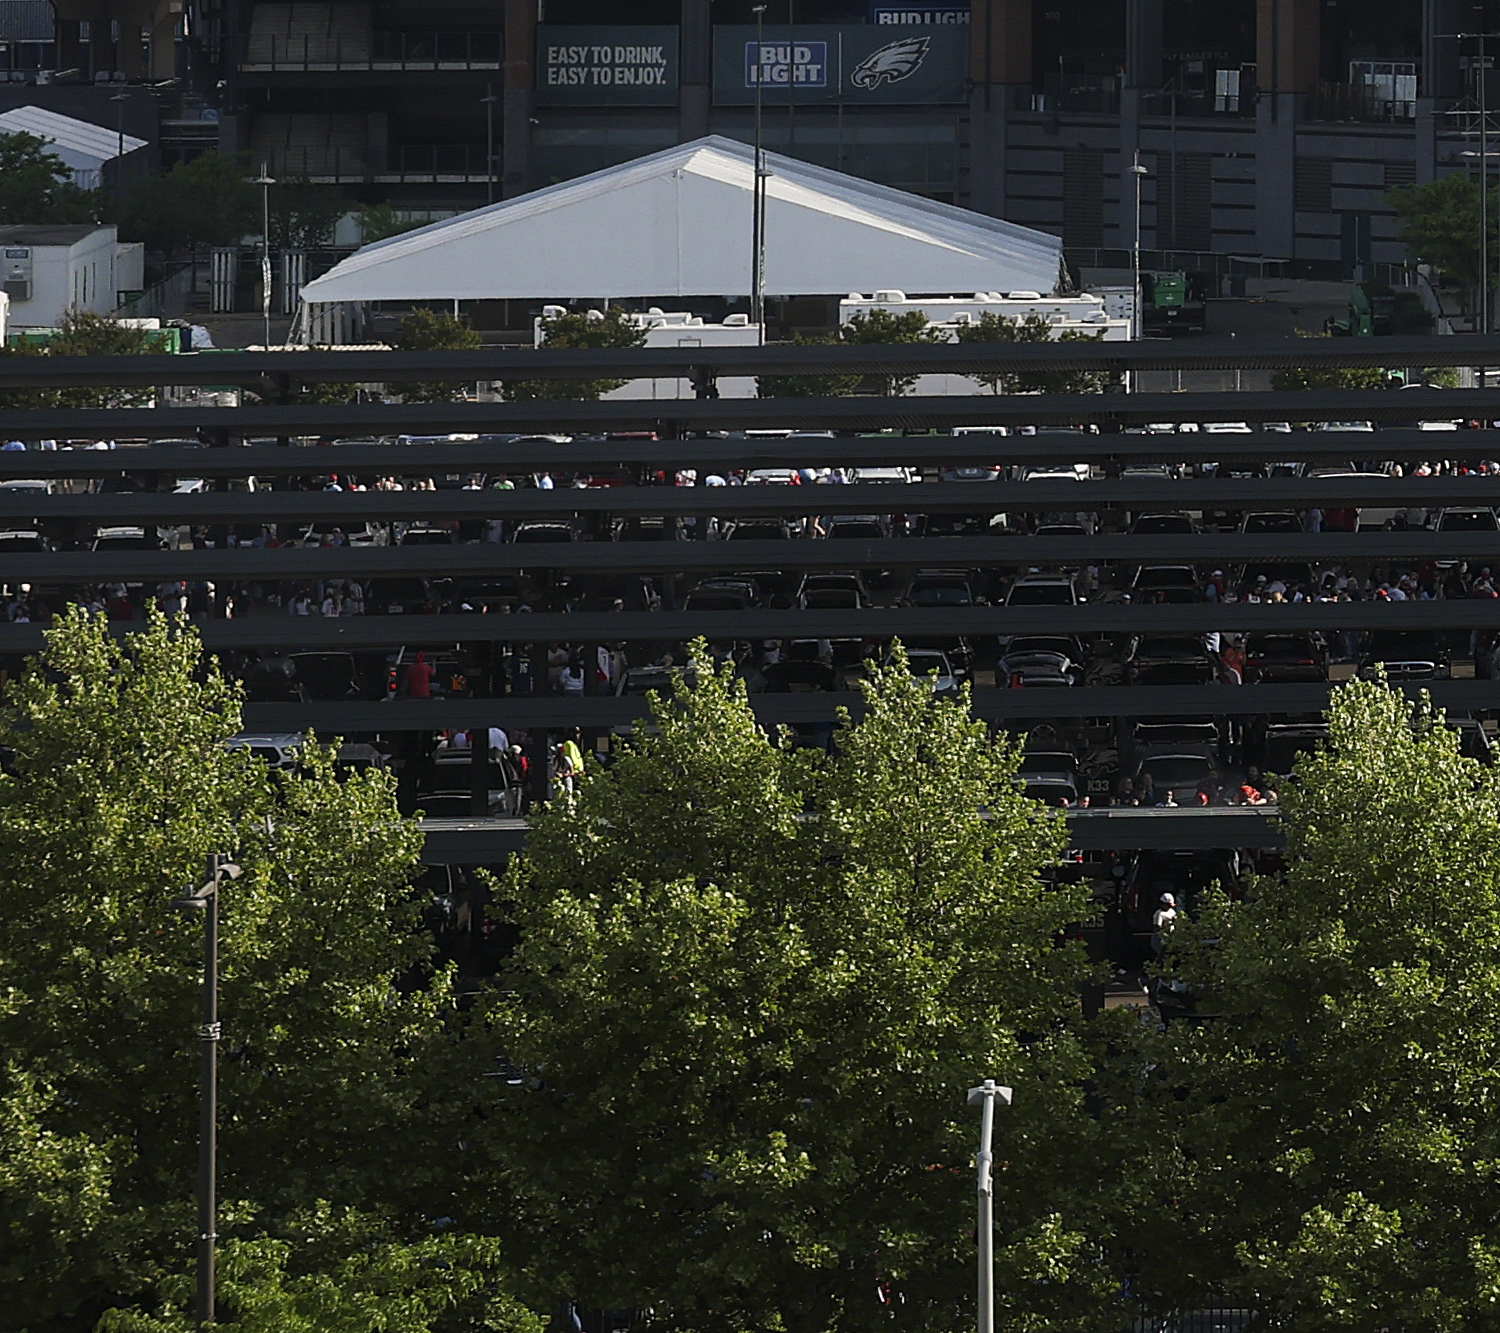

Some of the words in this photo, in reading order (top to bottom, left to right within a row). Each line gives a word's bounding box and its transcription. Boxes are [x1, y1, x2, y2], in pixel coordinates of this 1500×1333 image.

[548, 46, 588, 65] EASY
[592, 46, 611, 65] TO
[614, 46, 667, 67] DRINK,
[761, 47, 811, 64] BUD
[548, 68, 588, 85] EASY
[592, 68, 611, 85] TO
[614, 68, 667, 86] ENJOY.
[750, 64, 821, 82] LIGHT
[1087, 779, 1110, 793] K33
